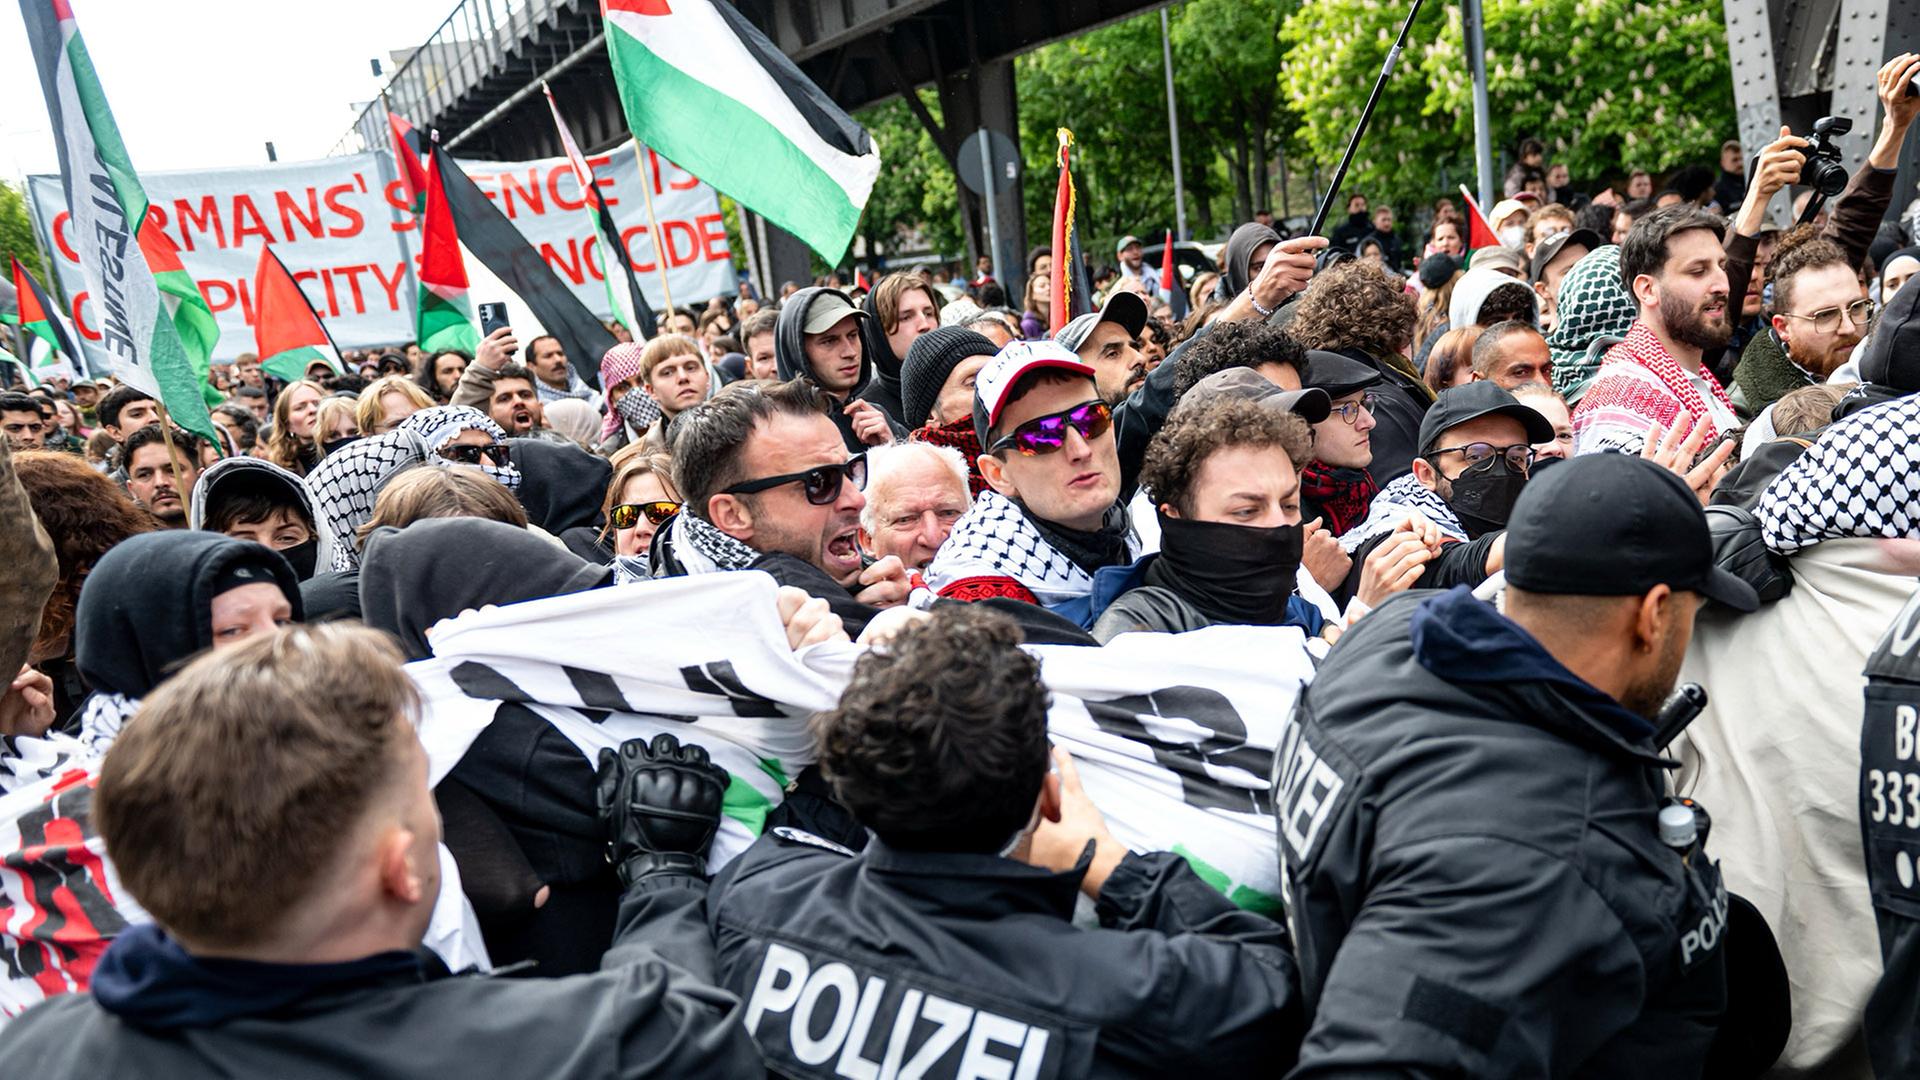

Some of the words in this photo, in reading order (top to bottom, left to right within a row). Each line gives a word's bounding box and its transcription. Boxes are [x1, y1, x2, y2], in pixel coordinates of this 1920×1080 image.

[53, 173, 367, 263] RMANS'
[384, 157, 619, 232] SNCE
[72, 262, 407, 341] CPLCITY
[533, 213, 731, 285] NOCIDE
[1895, 705, 1920, 760] B
[744, 943, 1049, 1080] POLIZEI
